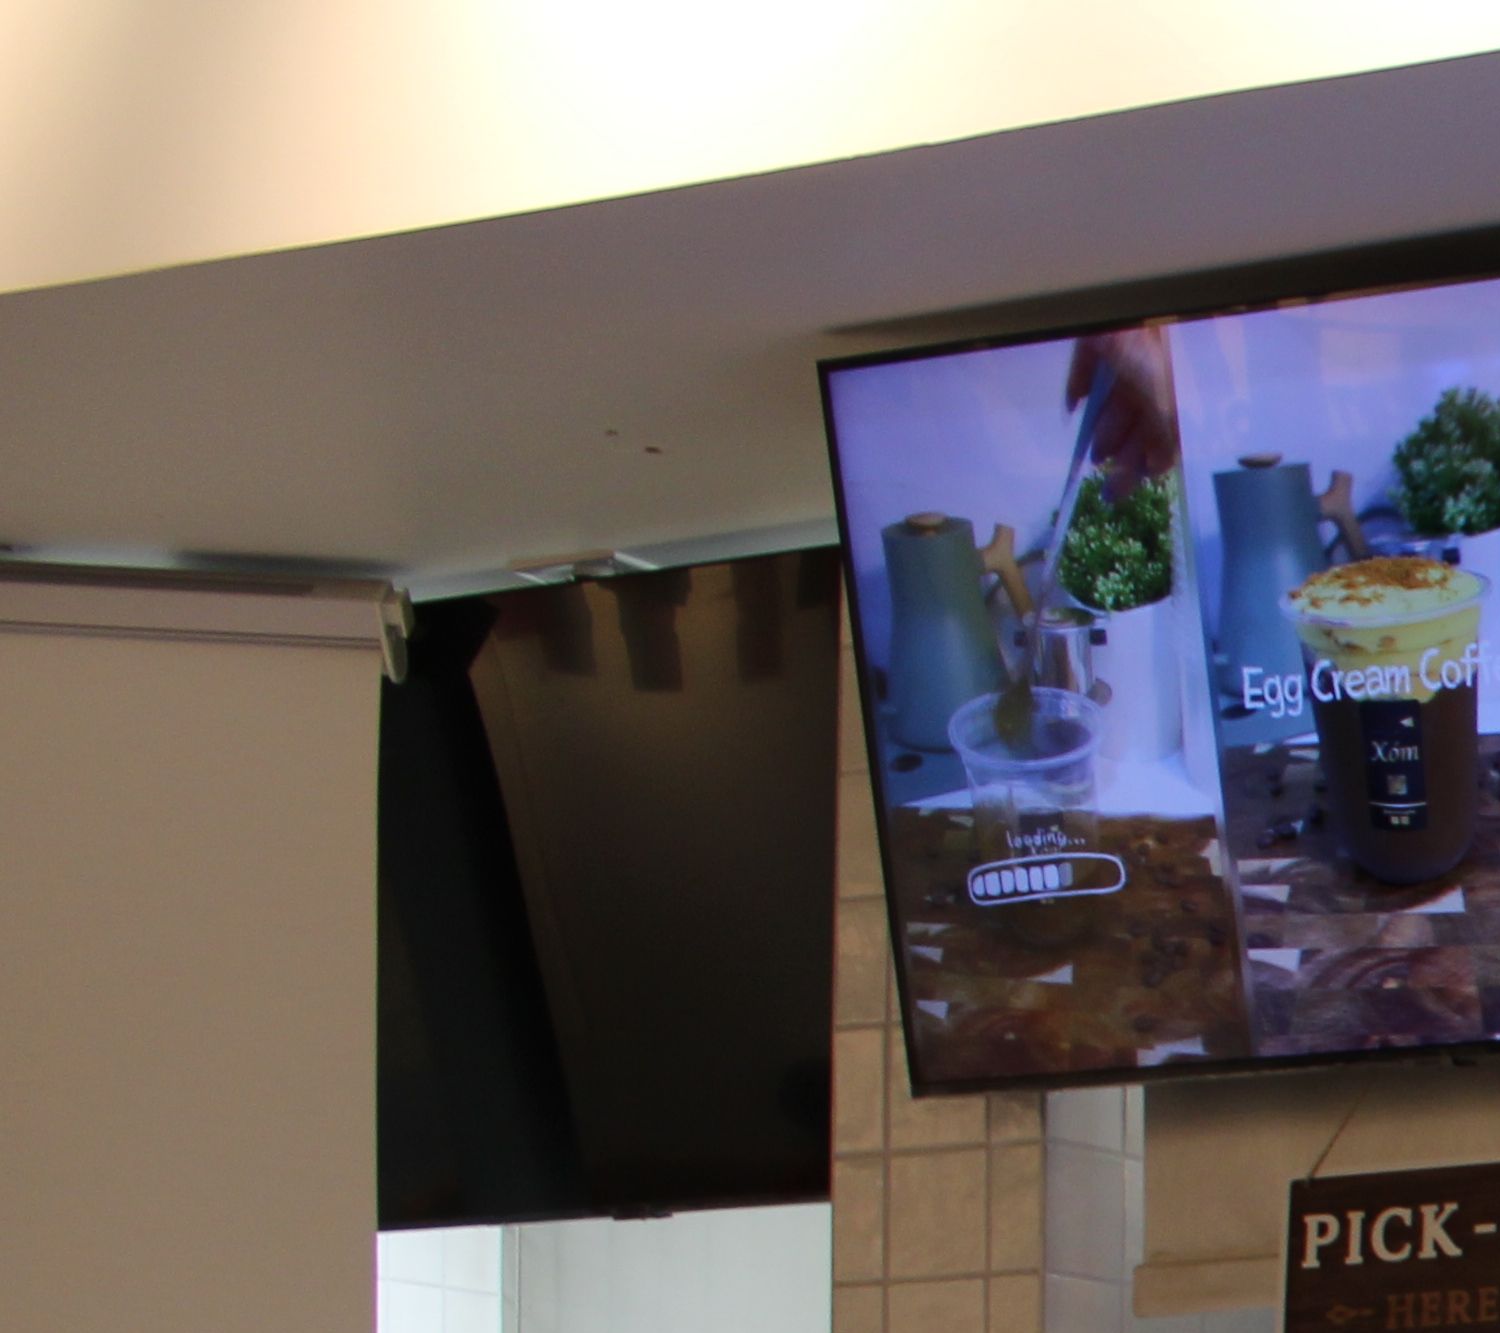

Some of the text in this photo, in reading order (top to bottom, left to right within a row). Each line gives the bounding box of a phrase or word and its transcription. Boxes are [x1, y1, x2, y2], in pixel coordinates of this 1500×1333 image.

[1243, 664, 1304, 717] Egg
[1312, 659, 1411, 703] Cream
[1387, 1286, 1500, 1330] HERE
